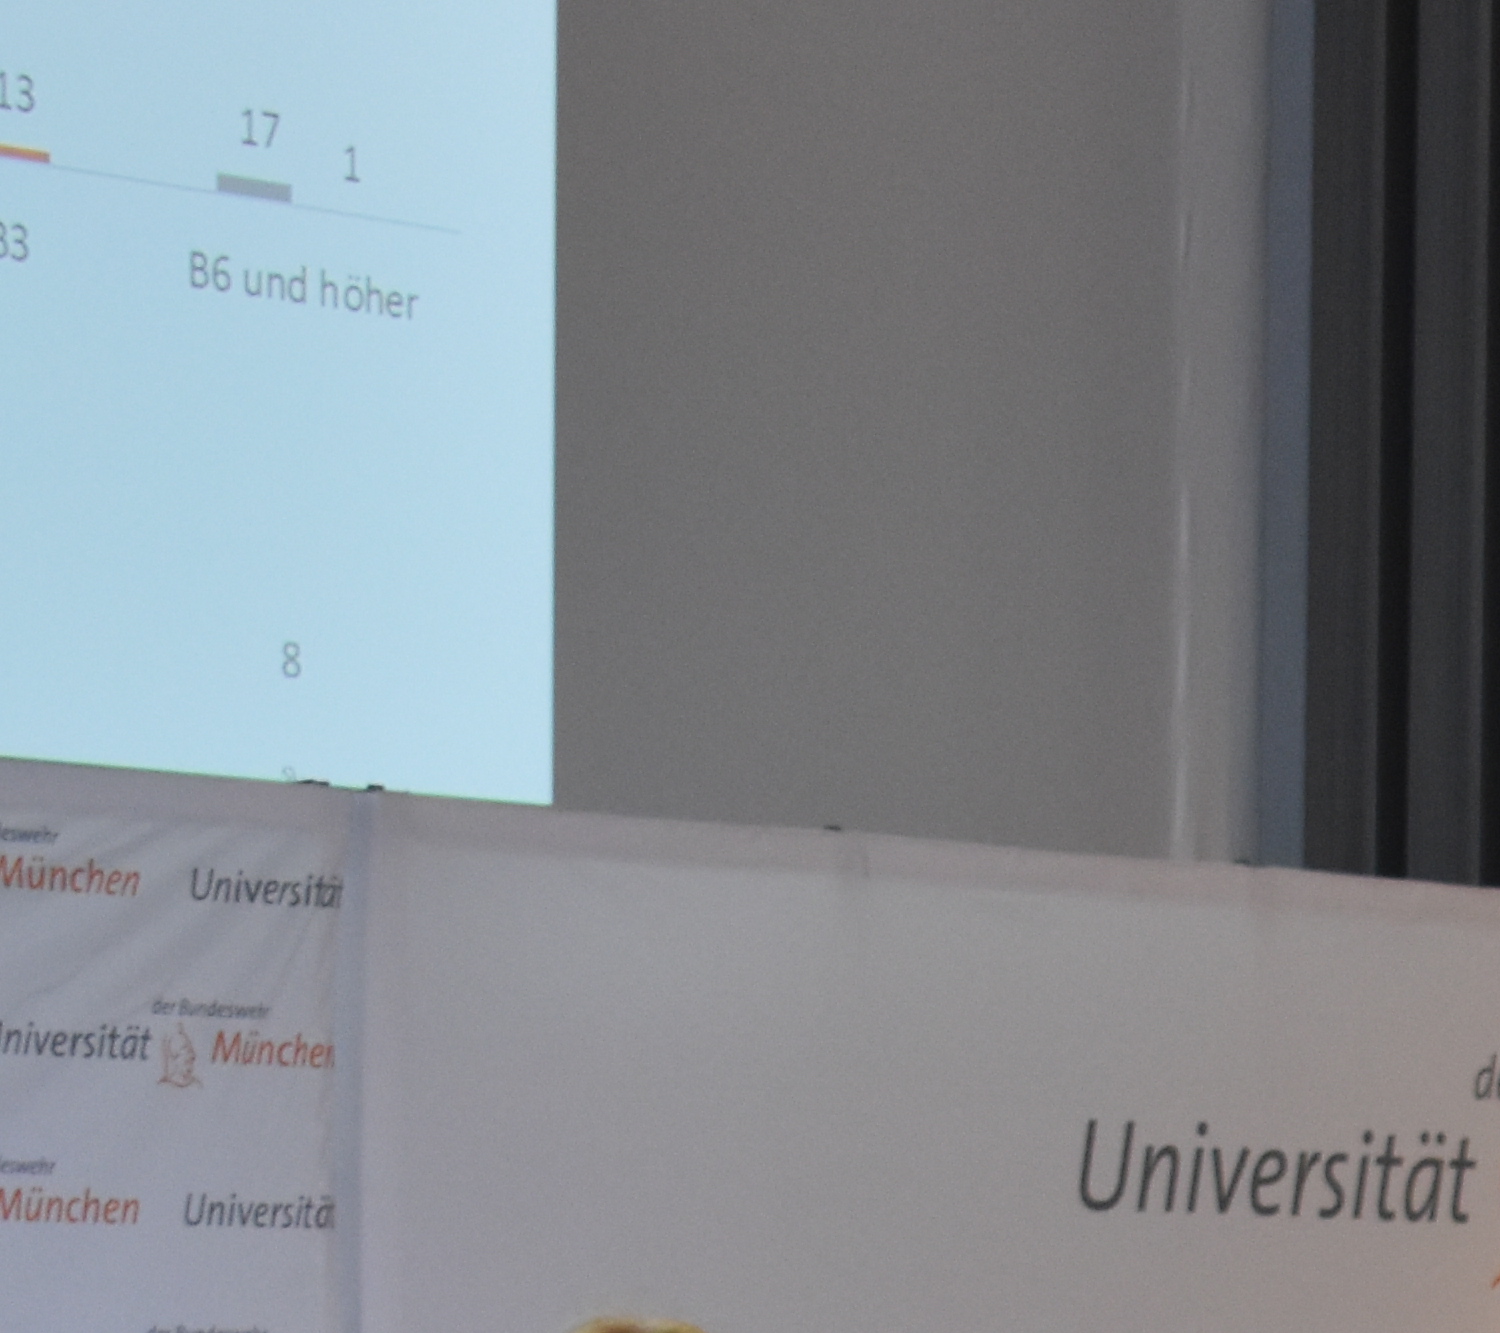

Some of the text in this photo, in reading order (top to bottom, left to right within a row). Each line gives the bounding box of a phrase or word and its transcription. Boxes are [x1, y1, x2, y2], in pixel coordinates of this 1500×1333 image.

[242, 109, 280, 147] 17
[345, 146, 360, 183] 1
[190, 251, 419, 319] B6 und höher
[282, 642, 301, 678] 8
[0, 855, 139, 895] München
[0, 1021, 152, 1060] niversität
[1079, 1120, 1476, 1223] Universität
[0, 1187, 139, 1224] München
